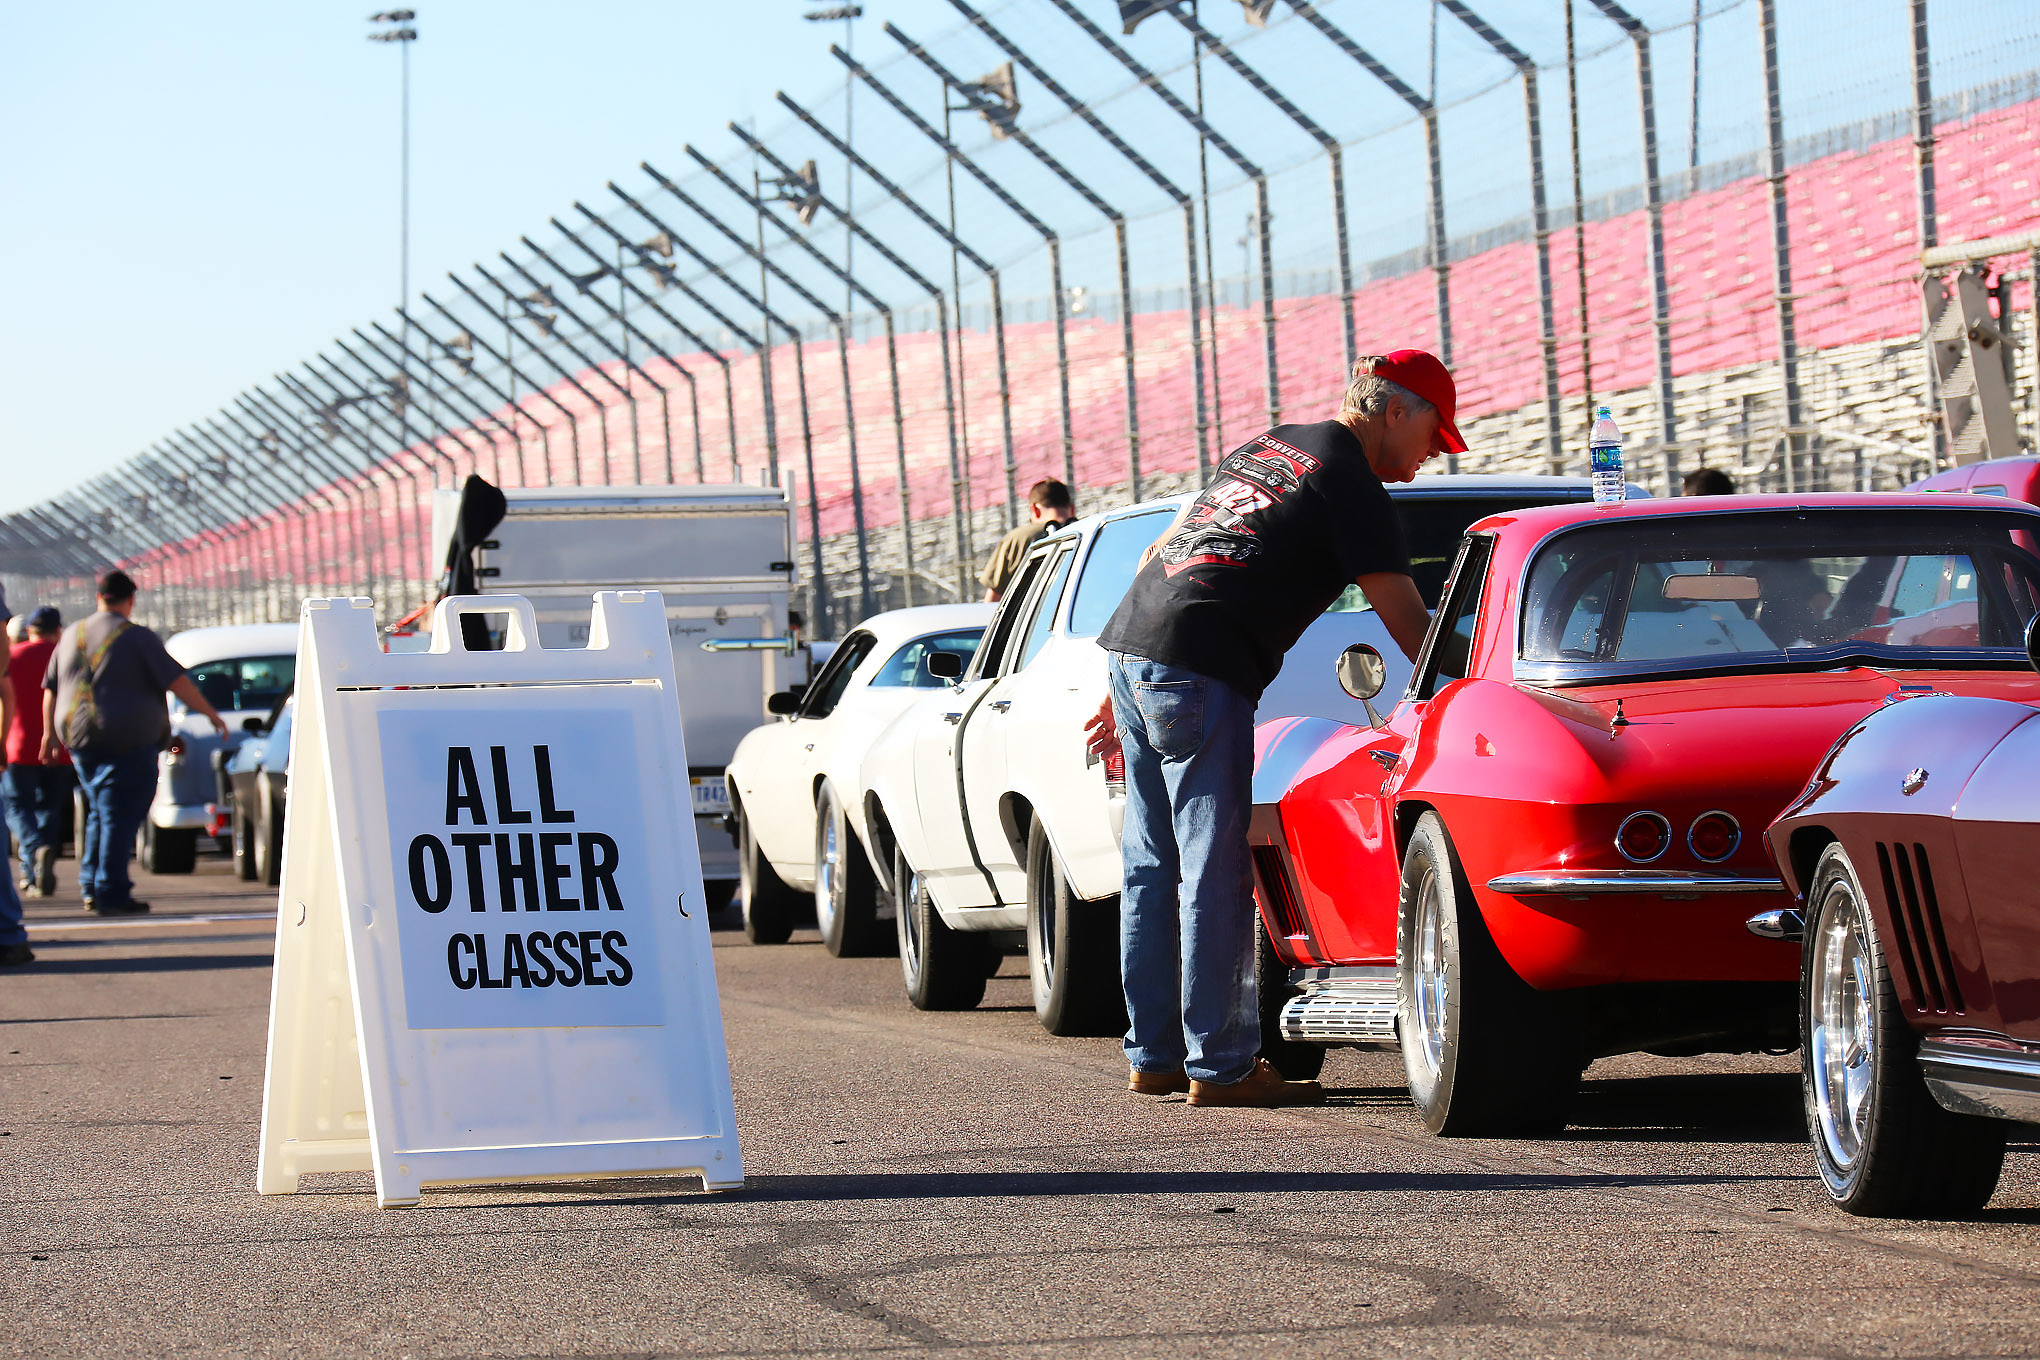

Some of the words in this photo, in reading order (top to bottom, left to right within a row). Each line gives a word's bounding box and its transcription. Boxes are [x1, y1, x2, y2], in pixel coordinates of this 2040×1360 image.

[1257, 435, 1317, 470] CORVETTE
[1210, 479, 1274, 516] 427
[445, 744, 576, 826] ALL
[408, 831, 625, 914] OTHER
[447, 930, 634, 990] CLASSES
